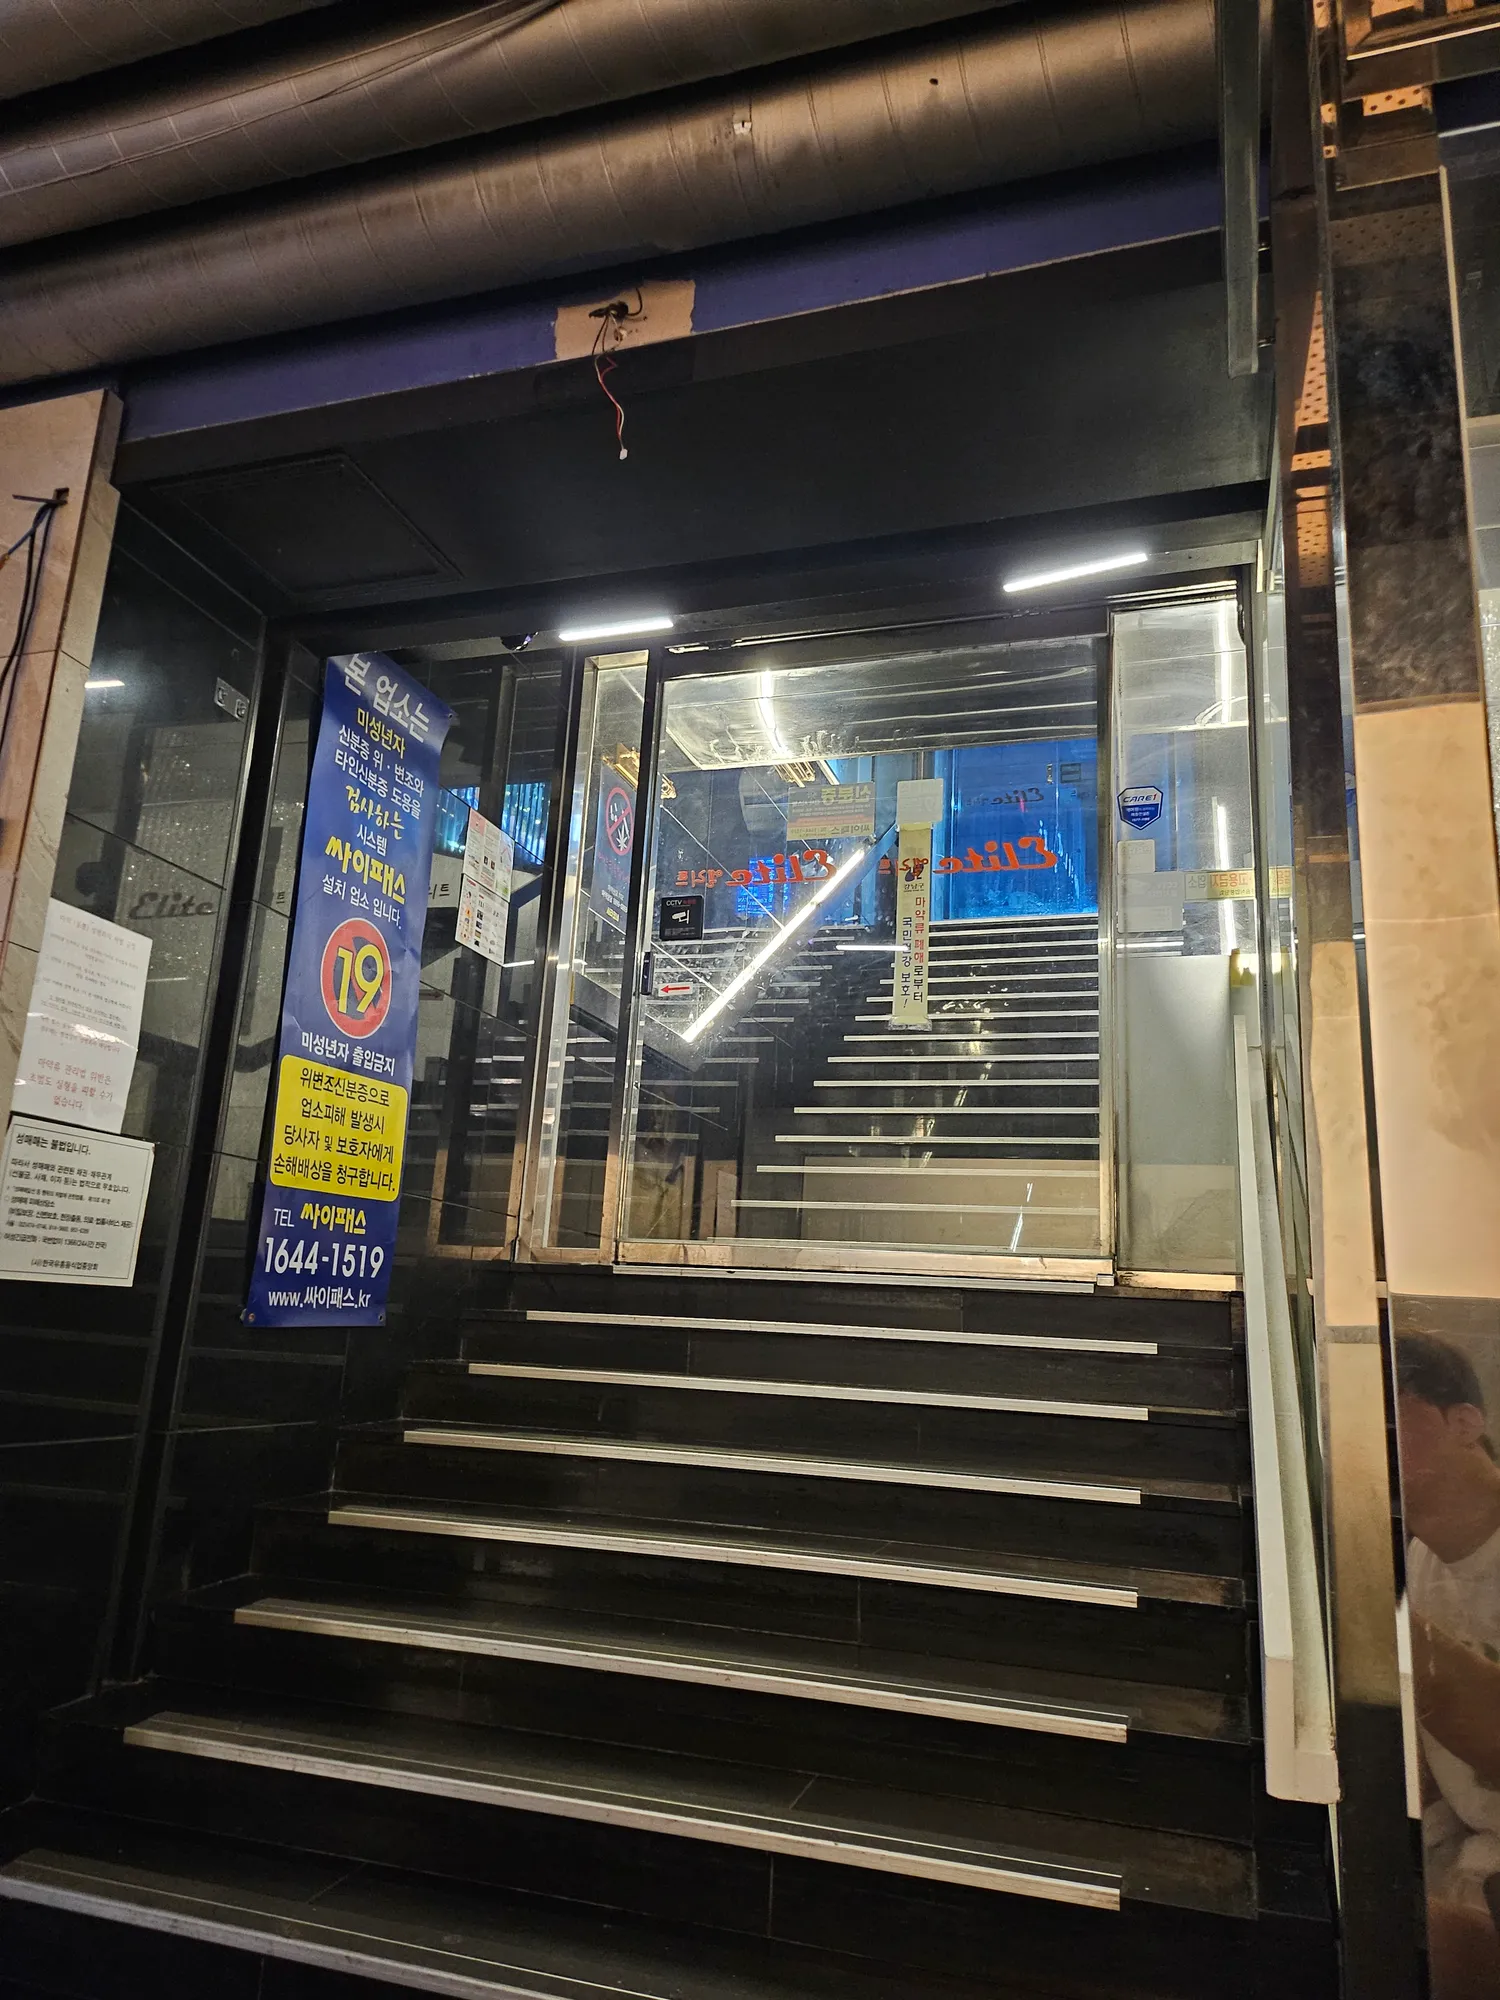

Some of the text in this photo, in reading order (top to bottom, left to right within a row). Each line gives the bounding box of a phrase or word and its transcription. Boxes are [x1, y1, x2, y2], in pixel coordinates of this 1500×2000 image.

[344, 653, 430, 743] 본 업소는
[338, 724, 370, 760] 신분증
[357, 707, 406, 760] 미성년자
[334, 749, 421, 820] 타인신분증 도용을
[1123, 793, 1158, 803] CARE1
[346, 785, 405, 840] 검사하는
[356, 823, 387, 857] 시스템
[325, 835, 406, 904] 싸이패스
[128, 891, 217, 920] Elite
[322, 874, 402, 930] 설치 업소 입니다.
[666, 899, 682, 907] CCTV
[915, 897, 926, 934] 마약류
[337, 943, 385, 1014] 19
[38, 1057, 61, 1071] 마약류
[302, 1031, 395, 1077] 미성년자 출입금지
[300, 1066, 390, 1107] 위변조신분증으로
[301, 1098, 385, 1134] 업소피해 발생시
[16, 1133, 49, 1149] 성매매는
[283, 1124, 394, 1164] 당사자 및 보호자에게
[273, 1152, 396, 1192] 손해배상을 청구합니다.
[274, 1202, 367, 1235] TEL 싸이패스
[264, 1236, 384, 1279] 1644-1519
[268, 1286, 370, 1309] www.싸이패스.kr
